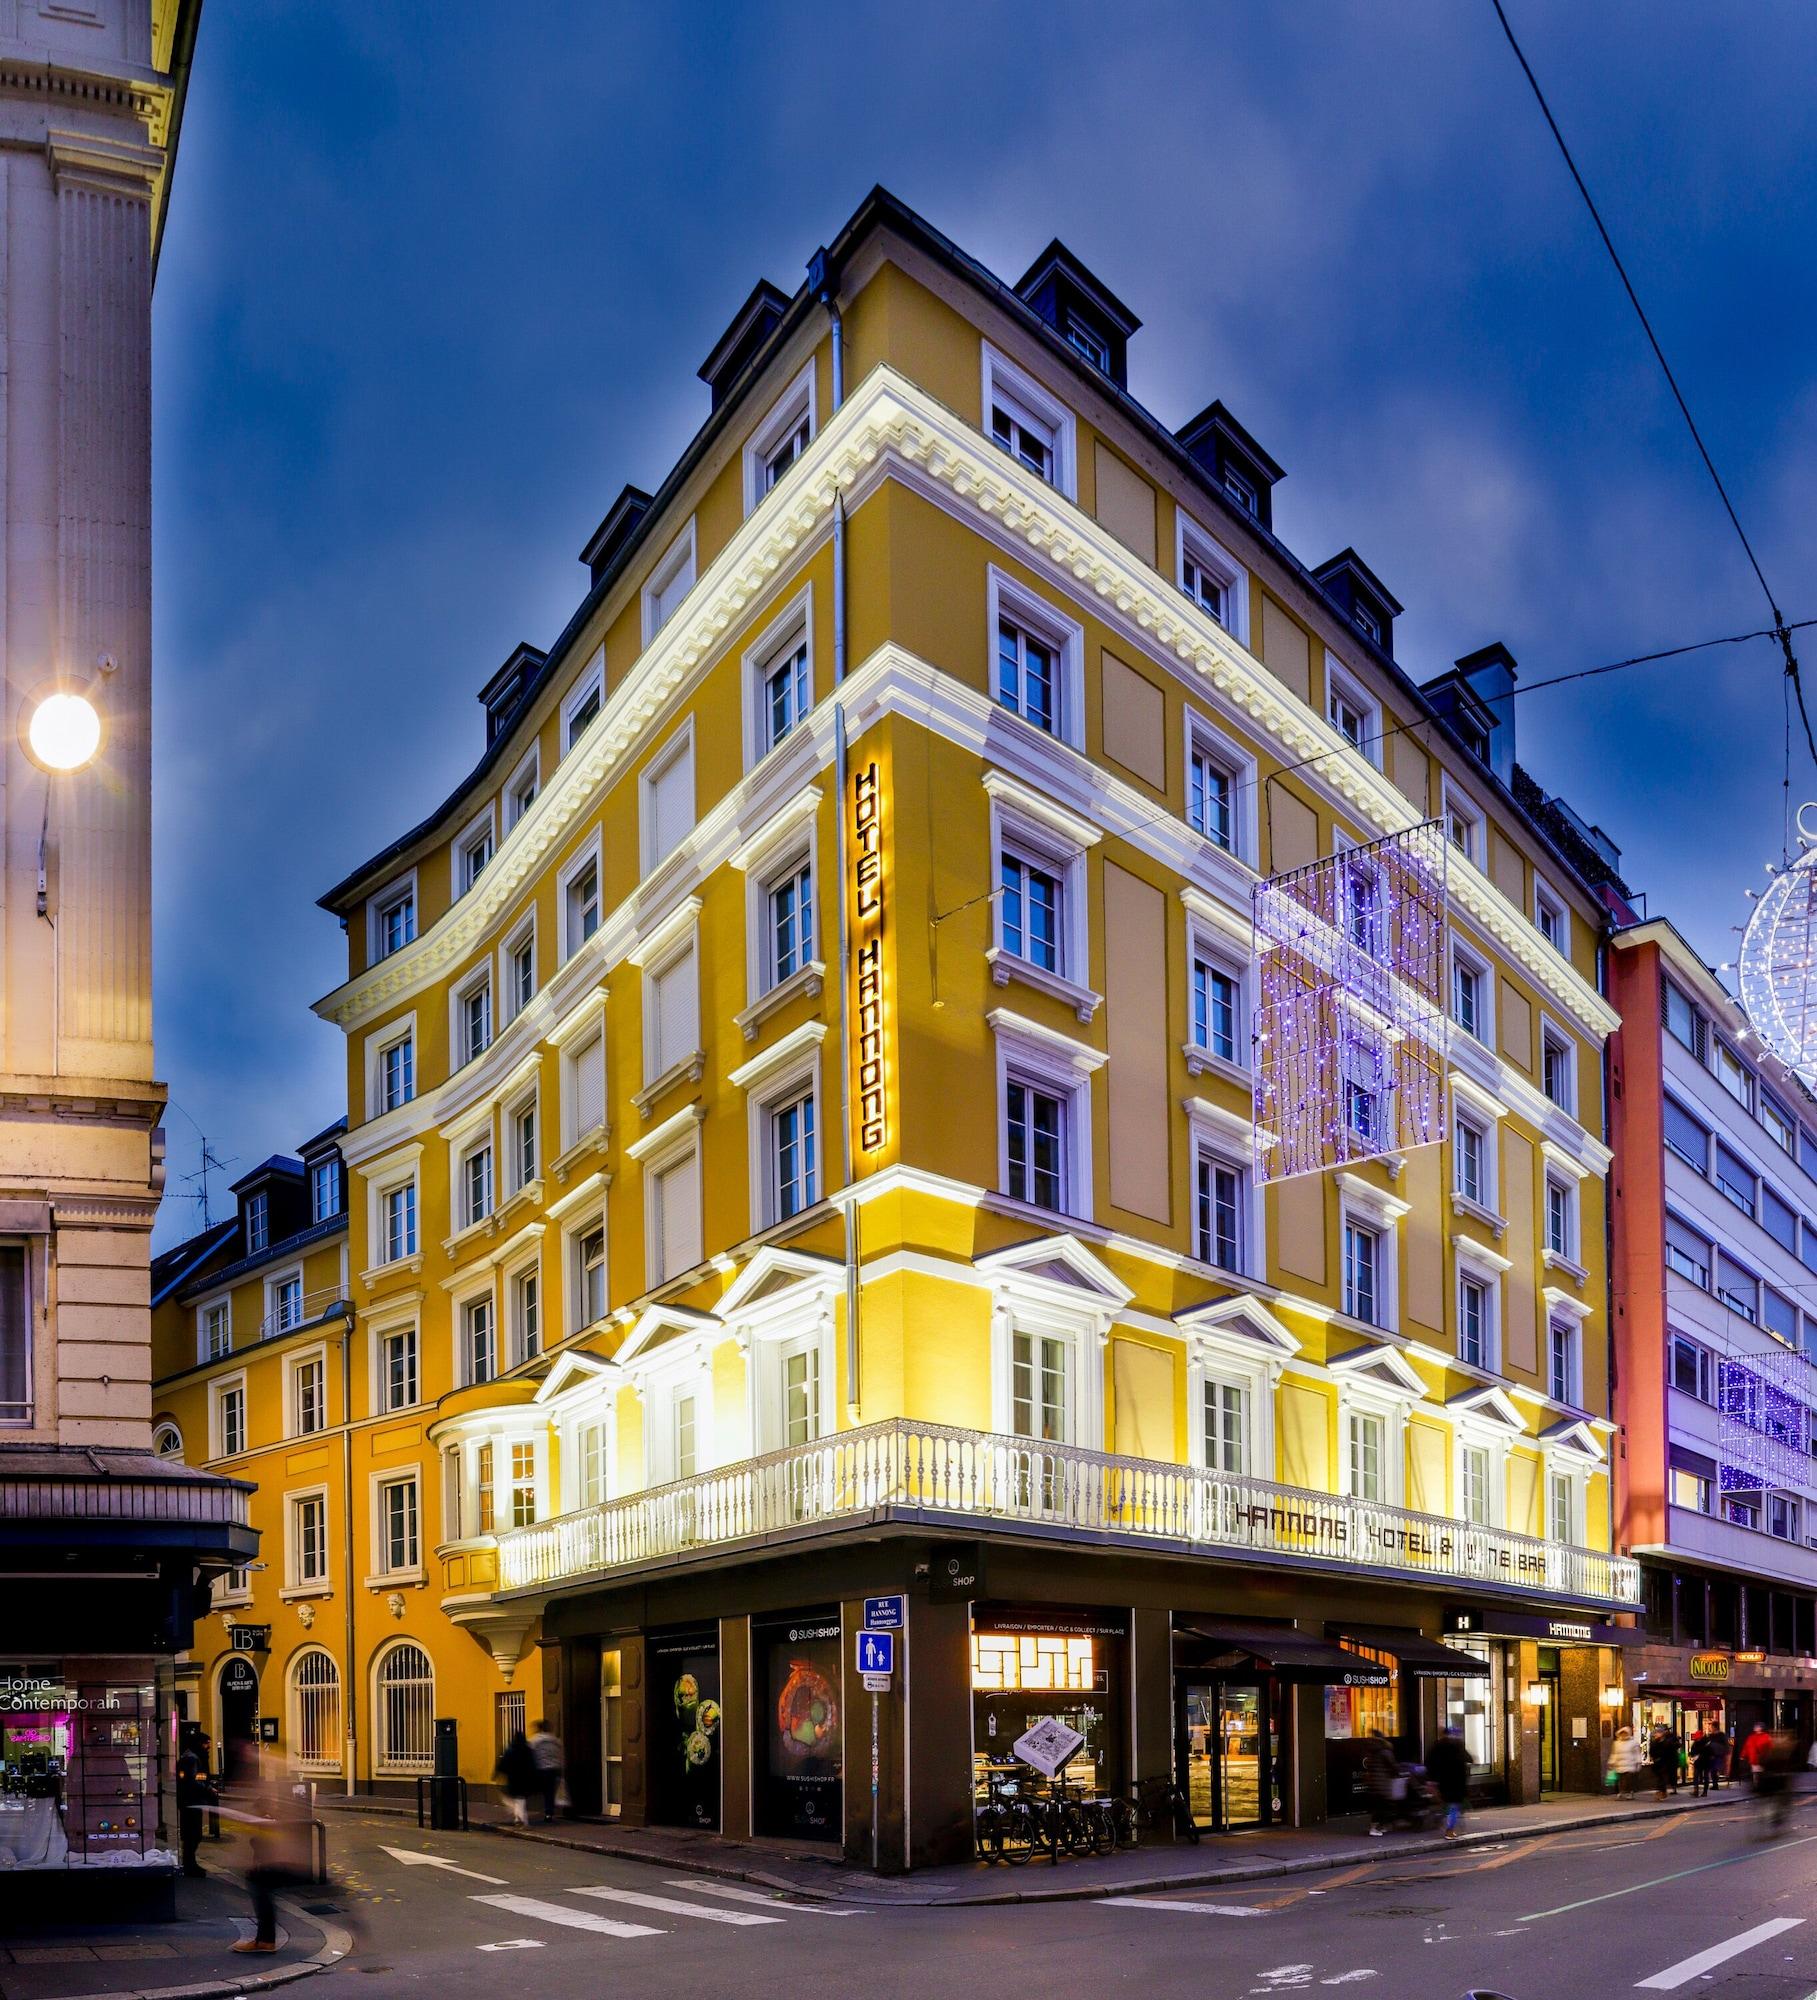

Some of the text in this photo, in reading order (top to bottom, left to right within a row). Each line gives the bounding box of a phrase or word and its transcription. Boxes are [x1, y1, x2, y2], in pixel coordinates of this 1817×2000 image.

[856, 763, 880, 918] HOTEL
[858, 939, 885, 1152] HANNONG
[1236, 1503, 1546, 1573] HANNONG HOTEL & WNE BAR
[953, 1576, 975, 1587] SHOP
[878, 1600, 889, 1608] RUE
[871, 1608, 897, 1617] HANNONG
[1457, 1616, 1470, 1629] H
[1549, 1623, 1592, 1639] HANNONG
[1693, 1660, 1728, 1677] NICOLAS
[0, 1695, 120, 1714] Contemporain
